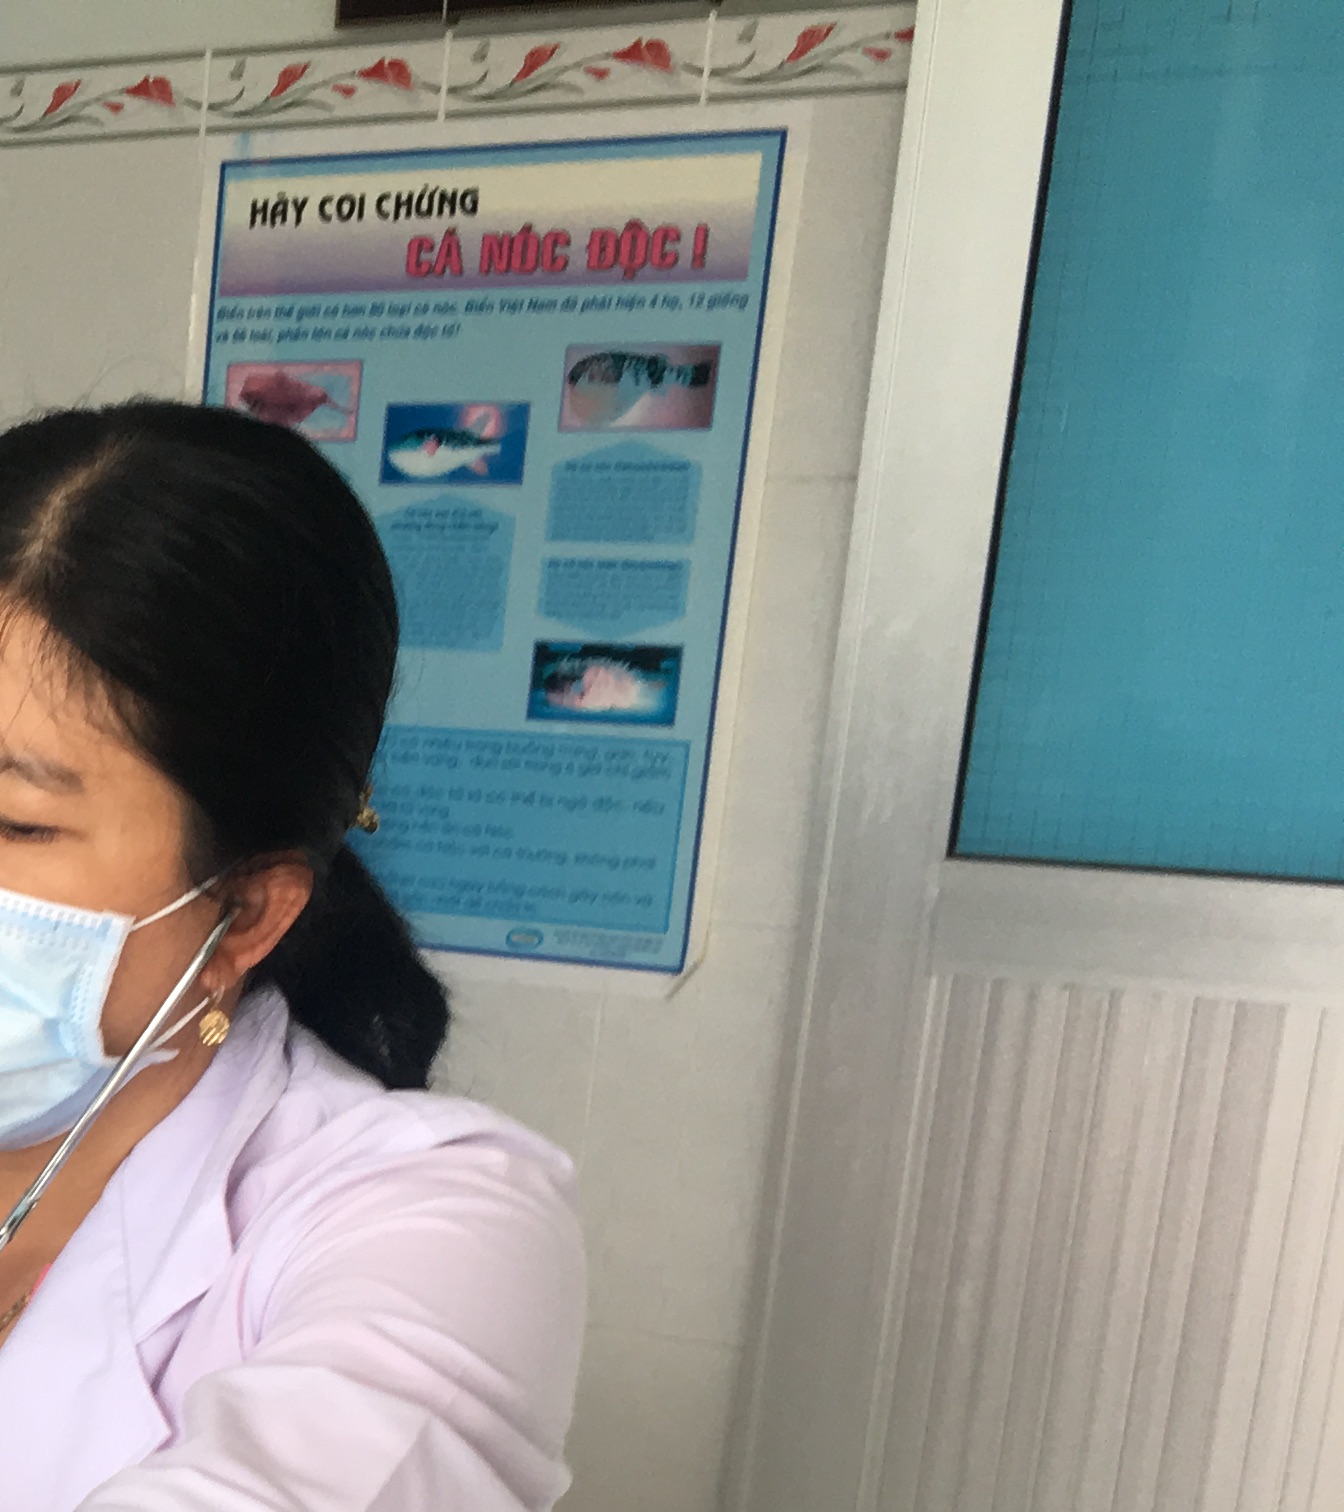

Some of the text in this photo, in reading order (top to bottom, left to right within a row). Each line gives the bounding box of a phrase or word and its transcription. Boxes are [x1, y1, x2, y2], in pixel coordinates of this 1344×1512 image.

[318, 192, 367, 223] COI
[405, 226, 463, 278] CÁ
[479, 222, 571, 276] NÓC
[586, 217, 681, 280] ĐỘC
